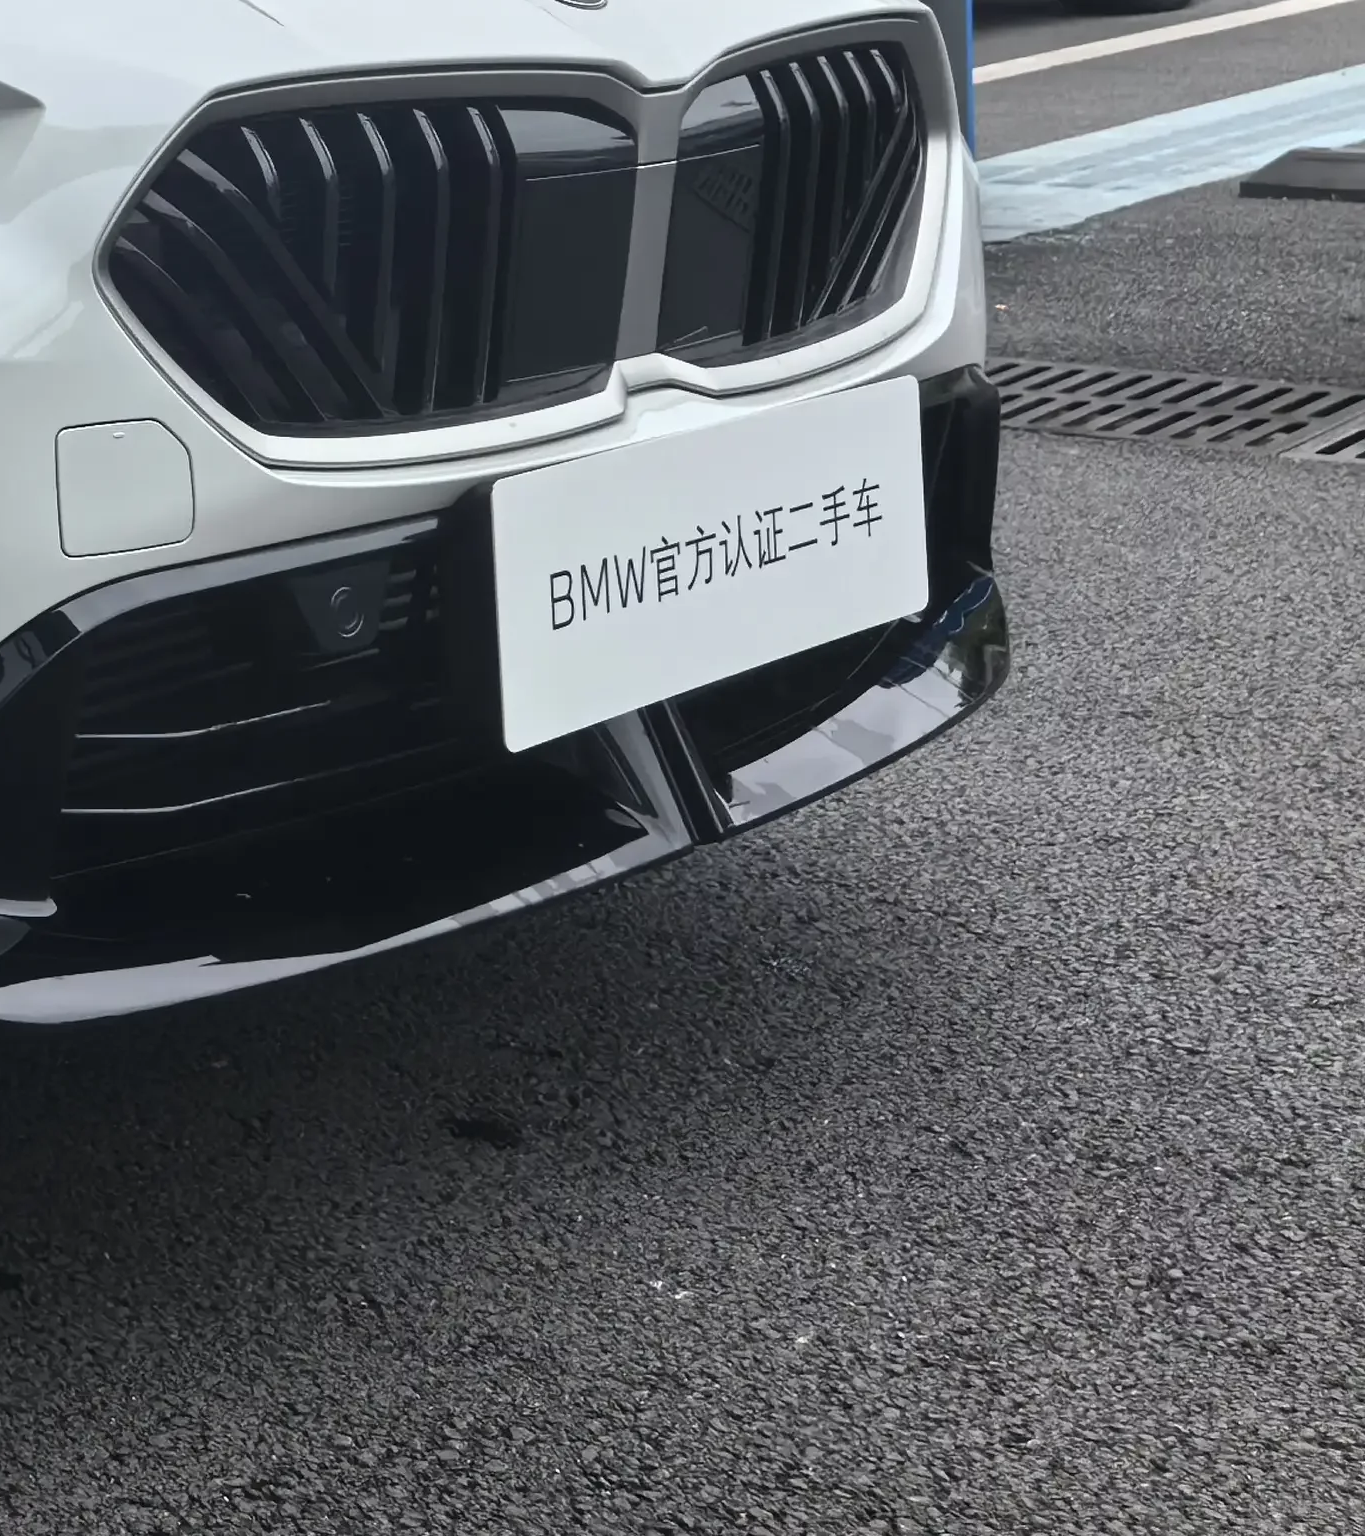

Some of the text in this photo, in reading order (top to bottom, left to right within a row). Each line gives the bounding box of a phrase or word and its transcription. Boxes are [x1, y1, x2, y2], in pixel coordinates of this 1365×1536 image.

[549, 477, 884, 631] BMW官方认证二手车
